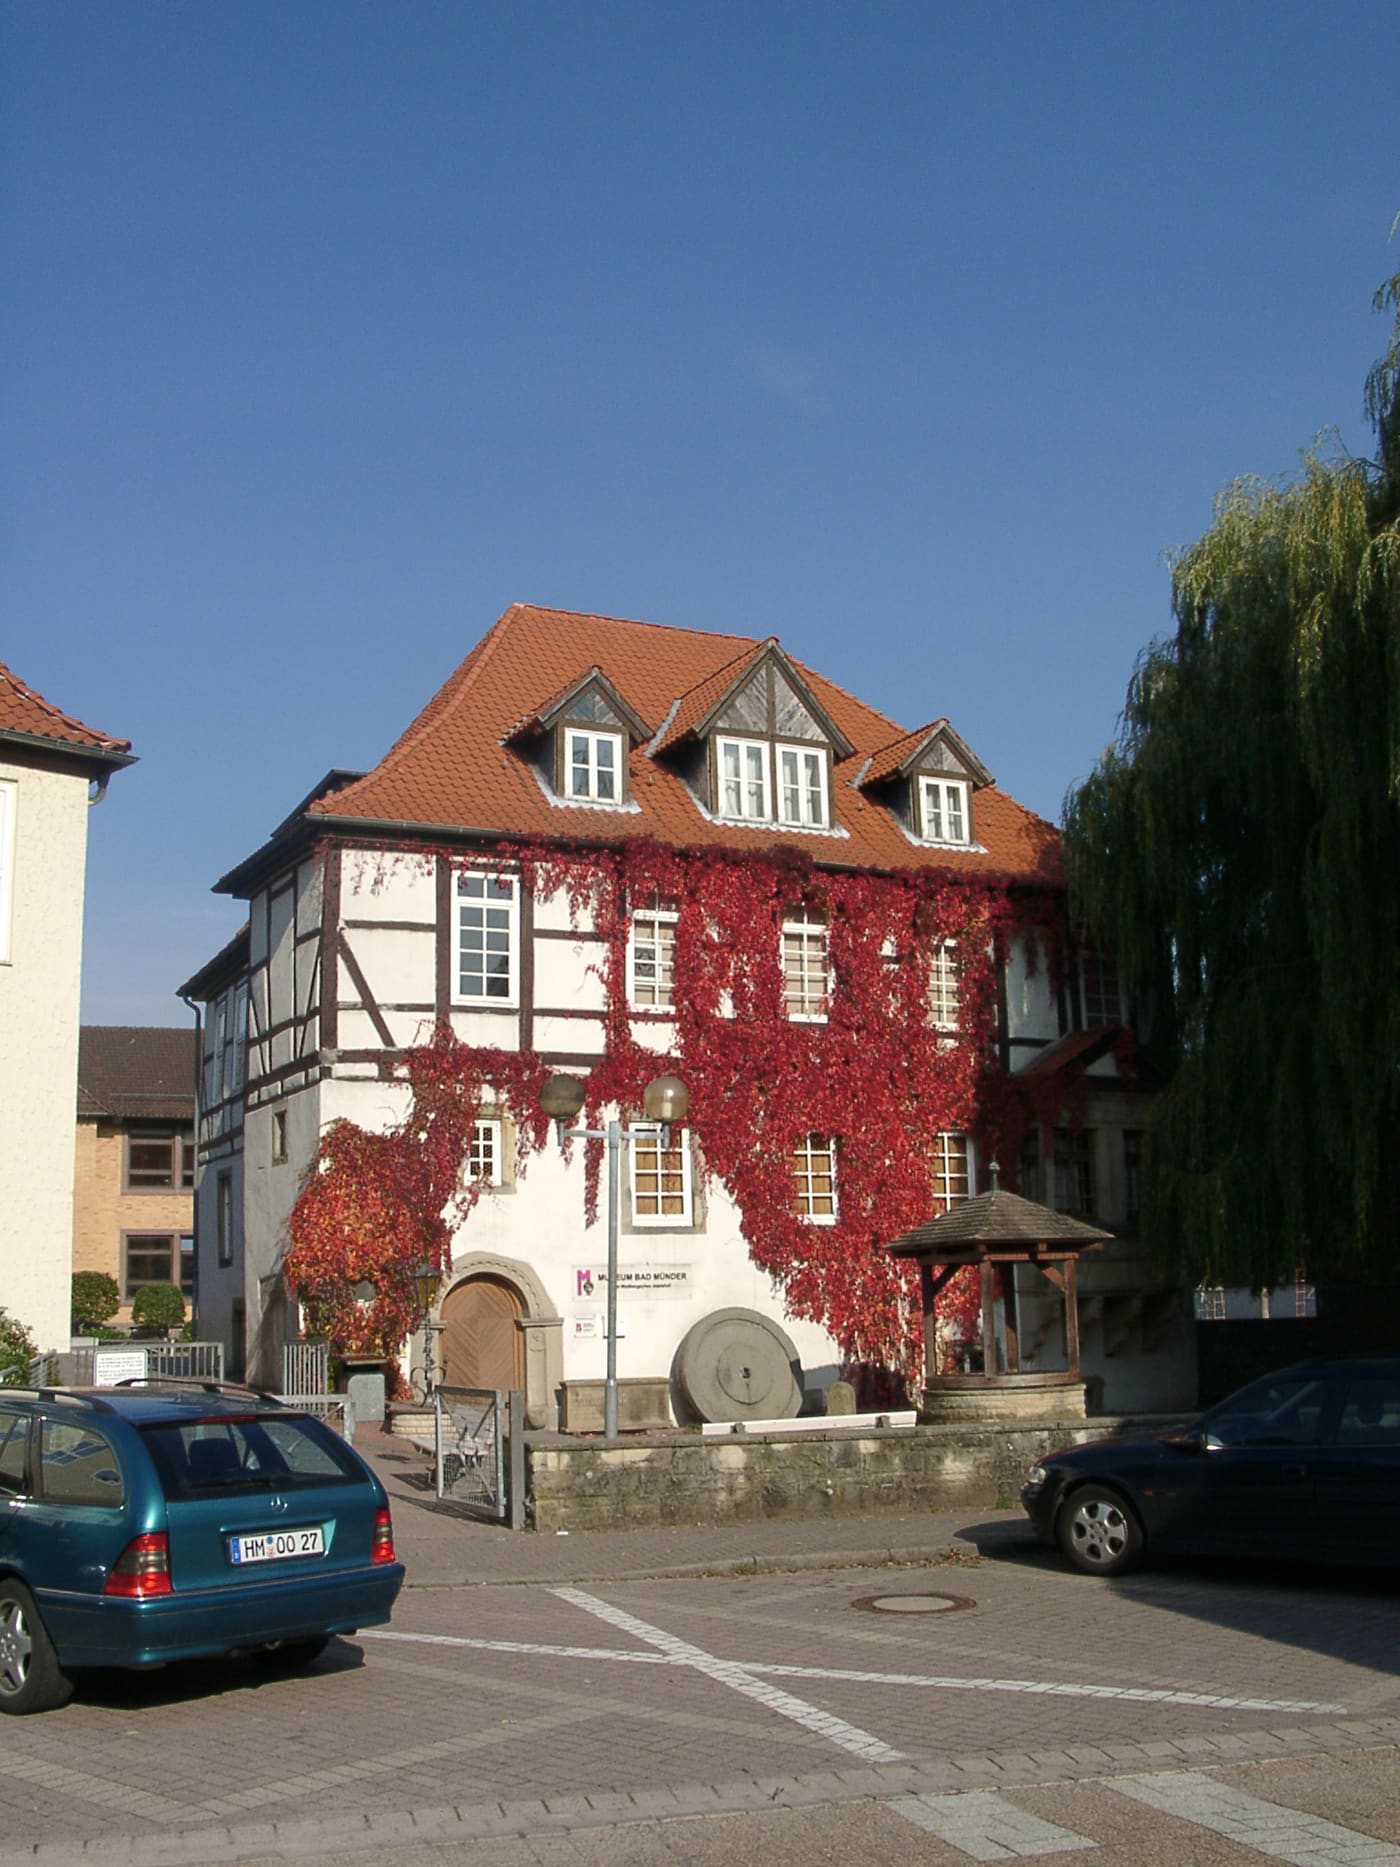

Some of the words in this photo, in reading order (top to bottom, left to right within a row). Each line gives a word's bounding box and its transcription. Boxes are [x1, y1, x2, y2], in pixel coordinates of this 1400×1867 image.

[598, 1273, 632, 1281] MUEUM
[634, 1273, 652, 1281] BAD
[653, 1271, 687, 1281] MÜNDER
[244, 1539, 266, 1558] HM
[301, 1532, 318, 1551] 27
